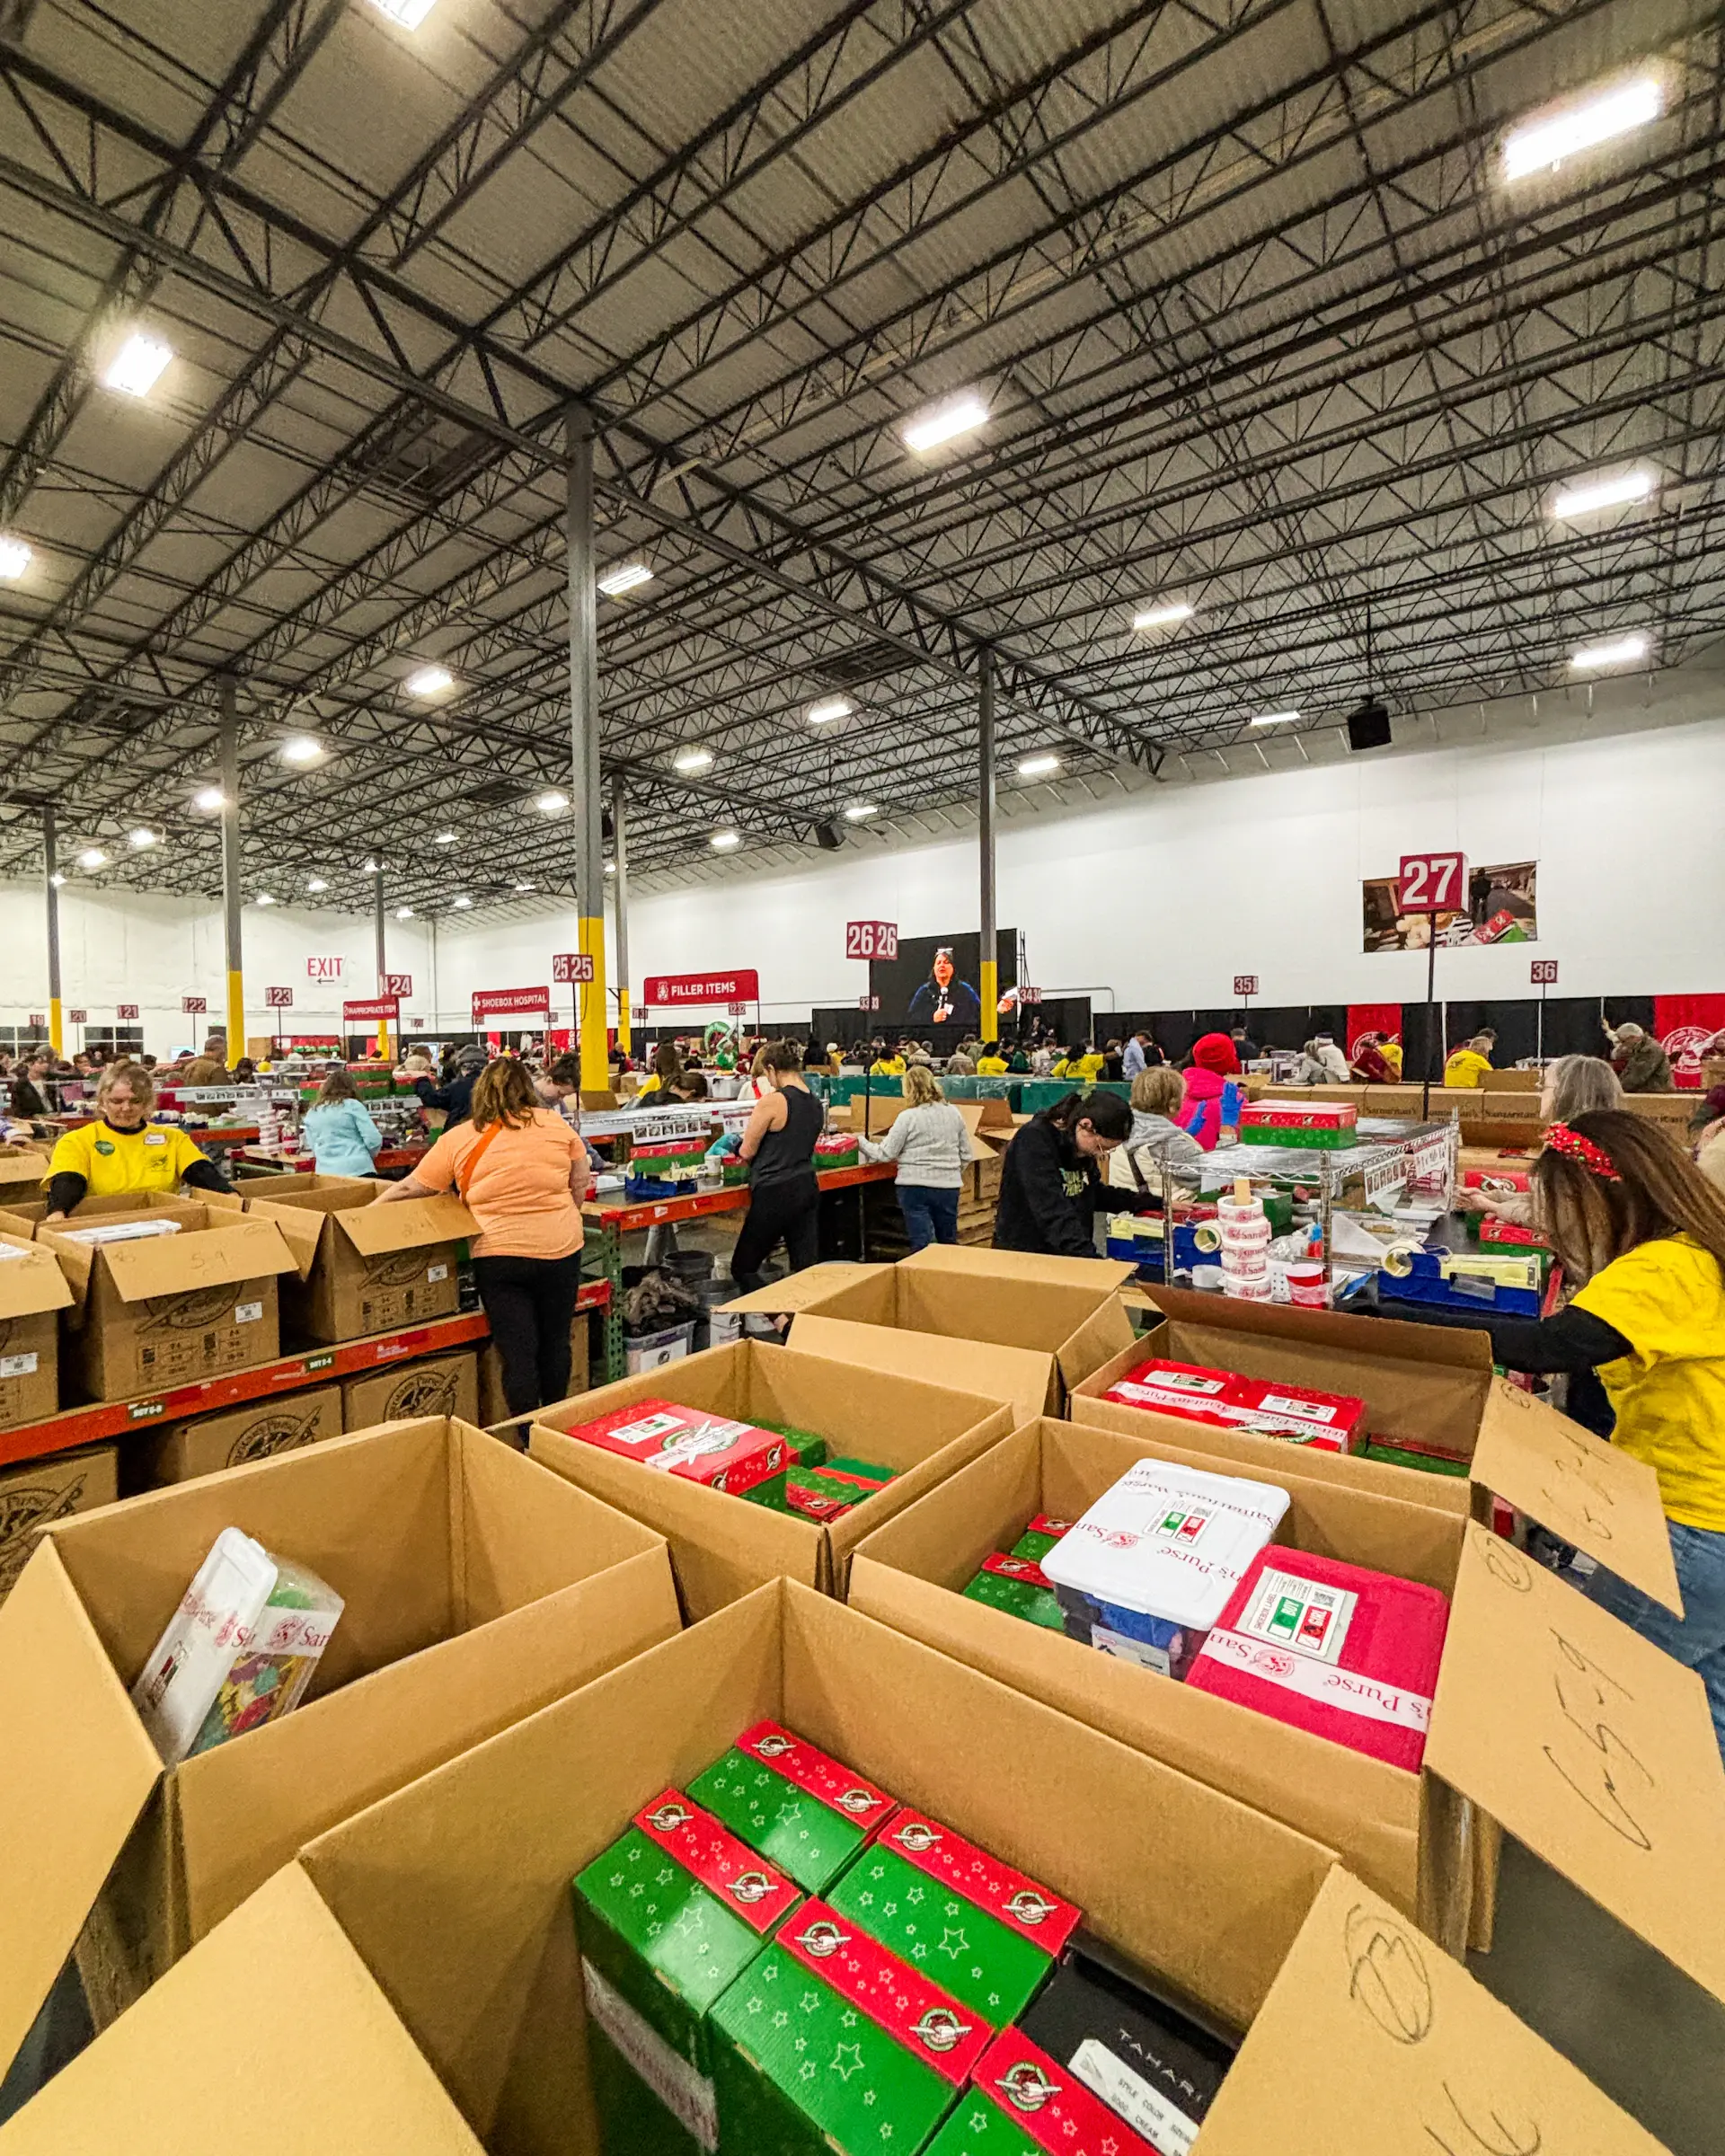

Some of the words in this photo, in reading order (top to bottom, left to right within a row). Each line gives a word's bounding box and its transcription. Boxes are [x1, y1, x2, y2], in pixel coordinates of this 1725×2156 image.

[1402, 858, 1457, 904] 27
[847, 924, 873, 955] 26
[877, 925, 897, 957] 26
[307, 958, 343, 976] EXIT
[553, 957, 568, 980] 25
[571, 957, 593, 980] 25
[1533, 962, 1557, 981] 36
[391, 976, 411, 995] 24
[671, 984, 703, 996] FILLER
[706, 981, 736, 994] ITEMS
[1234, 976, 1252, 993] 35
[274, 989, 292, 1004] 23
[482, 996, 513, 1008] SHOEBOX
[514, 994, 547, 1006] HOSPITAL
[1021, 989, 1033, 1002] 34
[124, 1005, 138, 1018] 21
[189, 999, 205, 1012] 22
[1282, 1598, 1301, 1617] BOY
[1254, 1608, 1269, 1631] SHOEBOX
[1310, 1608, 1330, 1628] GIRL
[1119, 2028, 1202, 2103] TAHARI
[1118, 2078, 1138, 2099] STYLE
[1143, 2099, 1163, 2122] COLOR
[1135, 2116, 1159, 2139] CREAM
